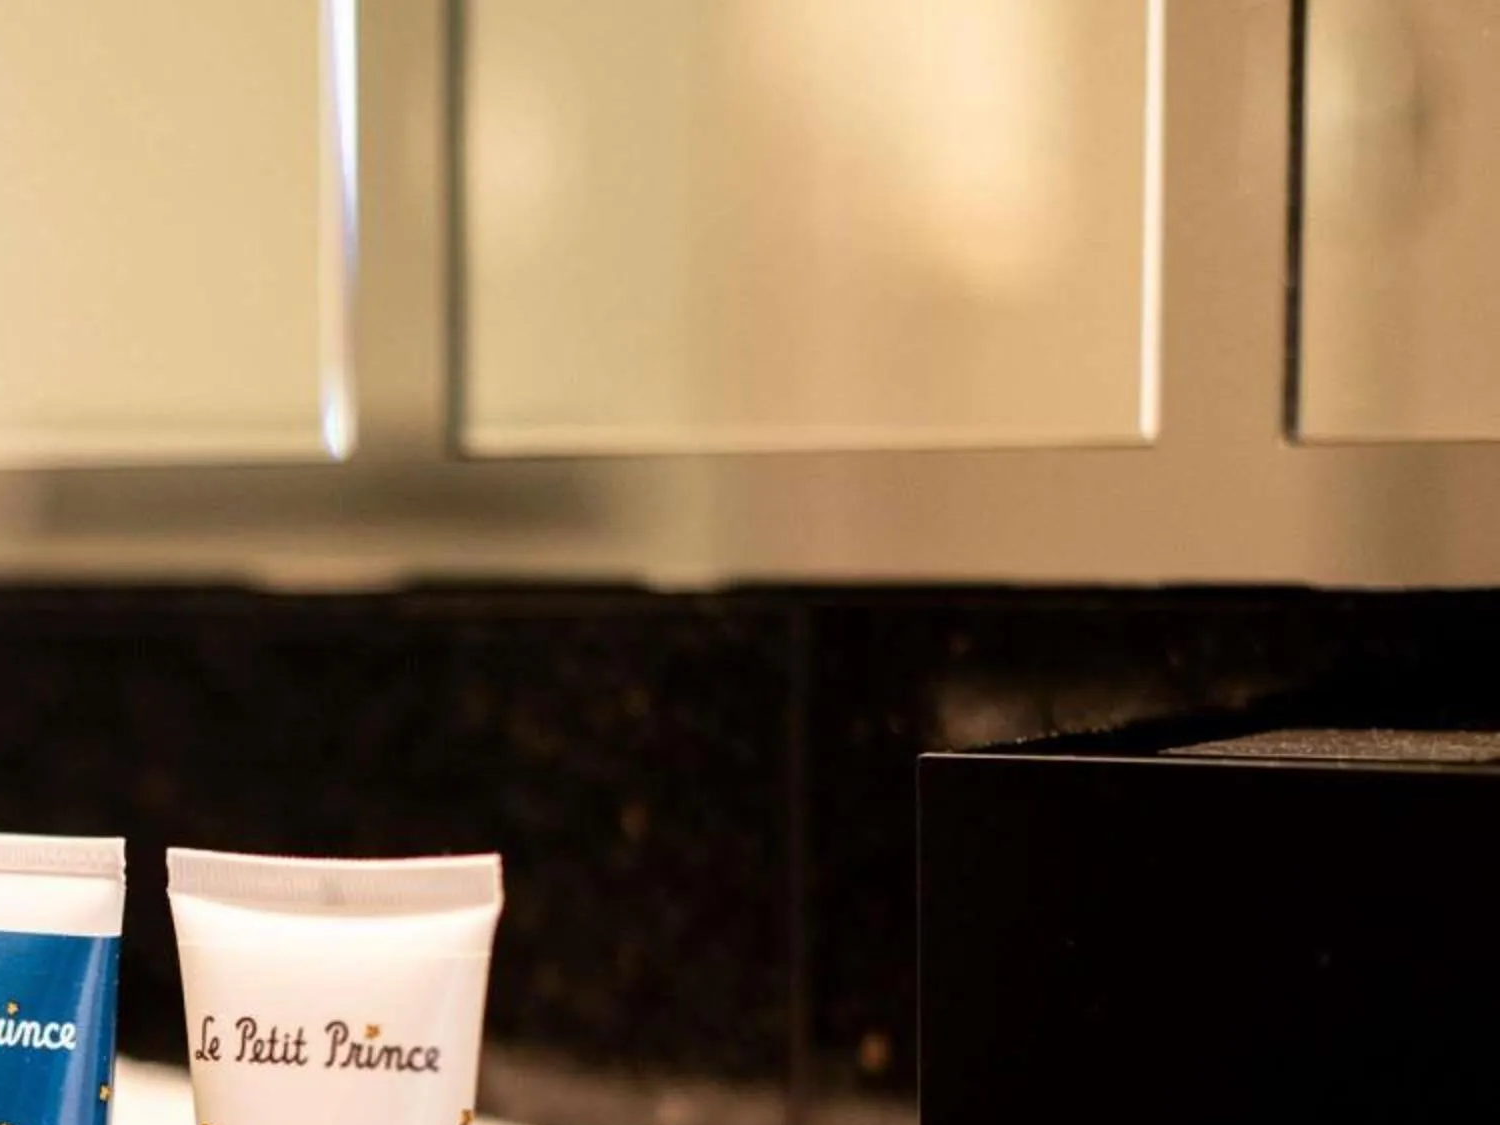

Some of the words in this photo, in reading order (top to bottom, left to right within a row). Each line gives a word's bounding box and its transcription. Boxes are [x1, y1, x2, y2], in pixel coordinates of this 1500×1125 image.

[196, 1015, 221, 1061] Le
[235, 1016, 308, 1066] Petit
[324, 1020, 441, 1073] Prince
